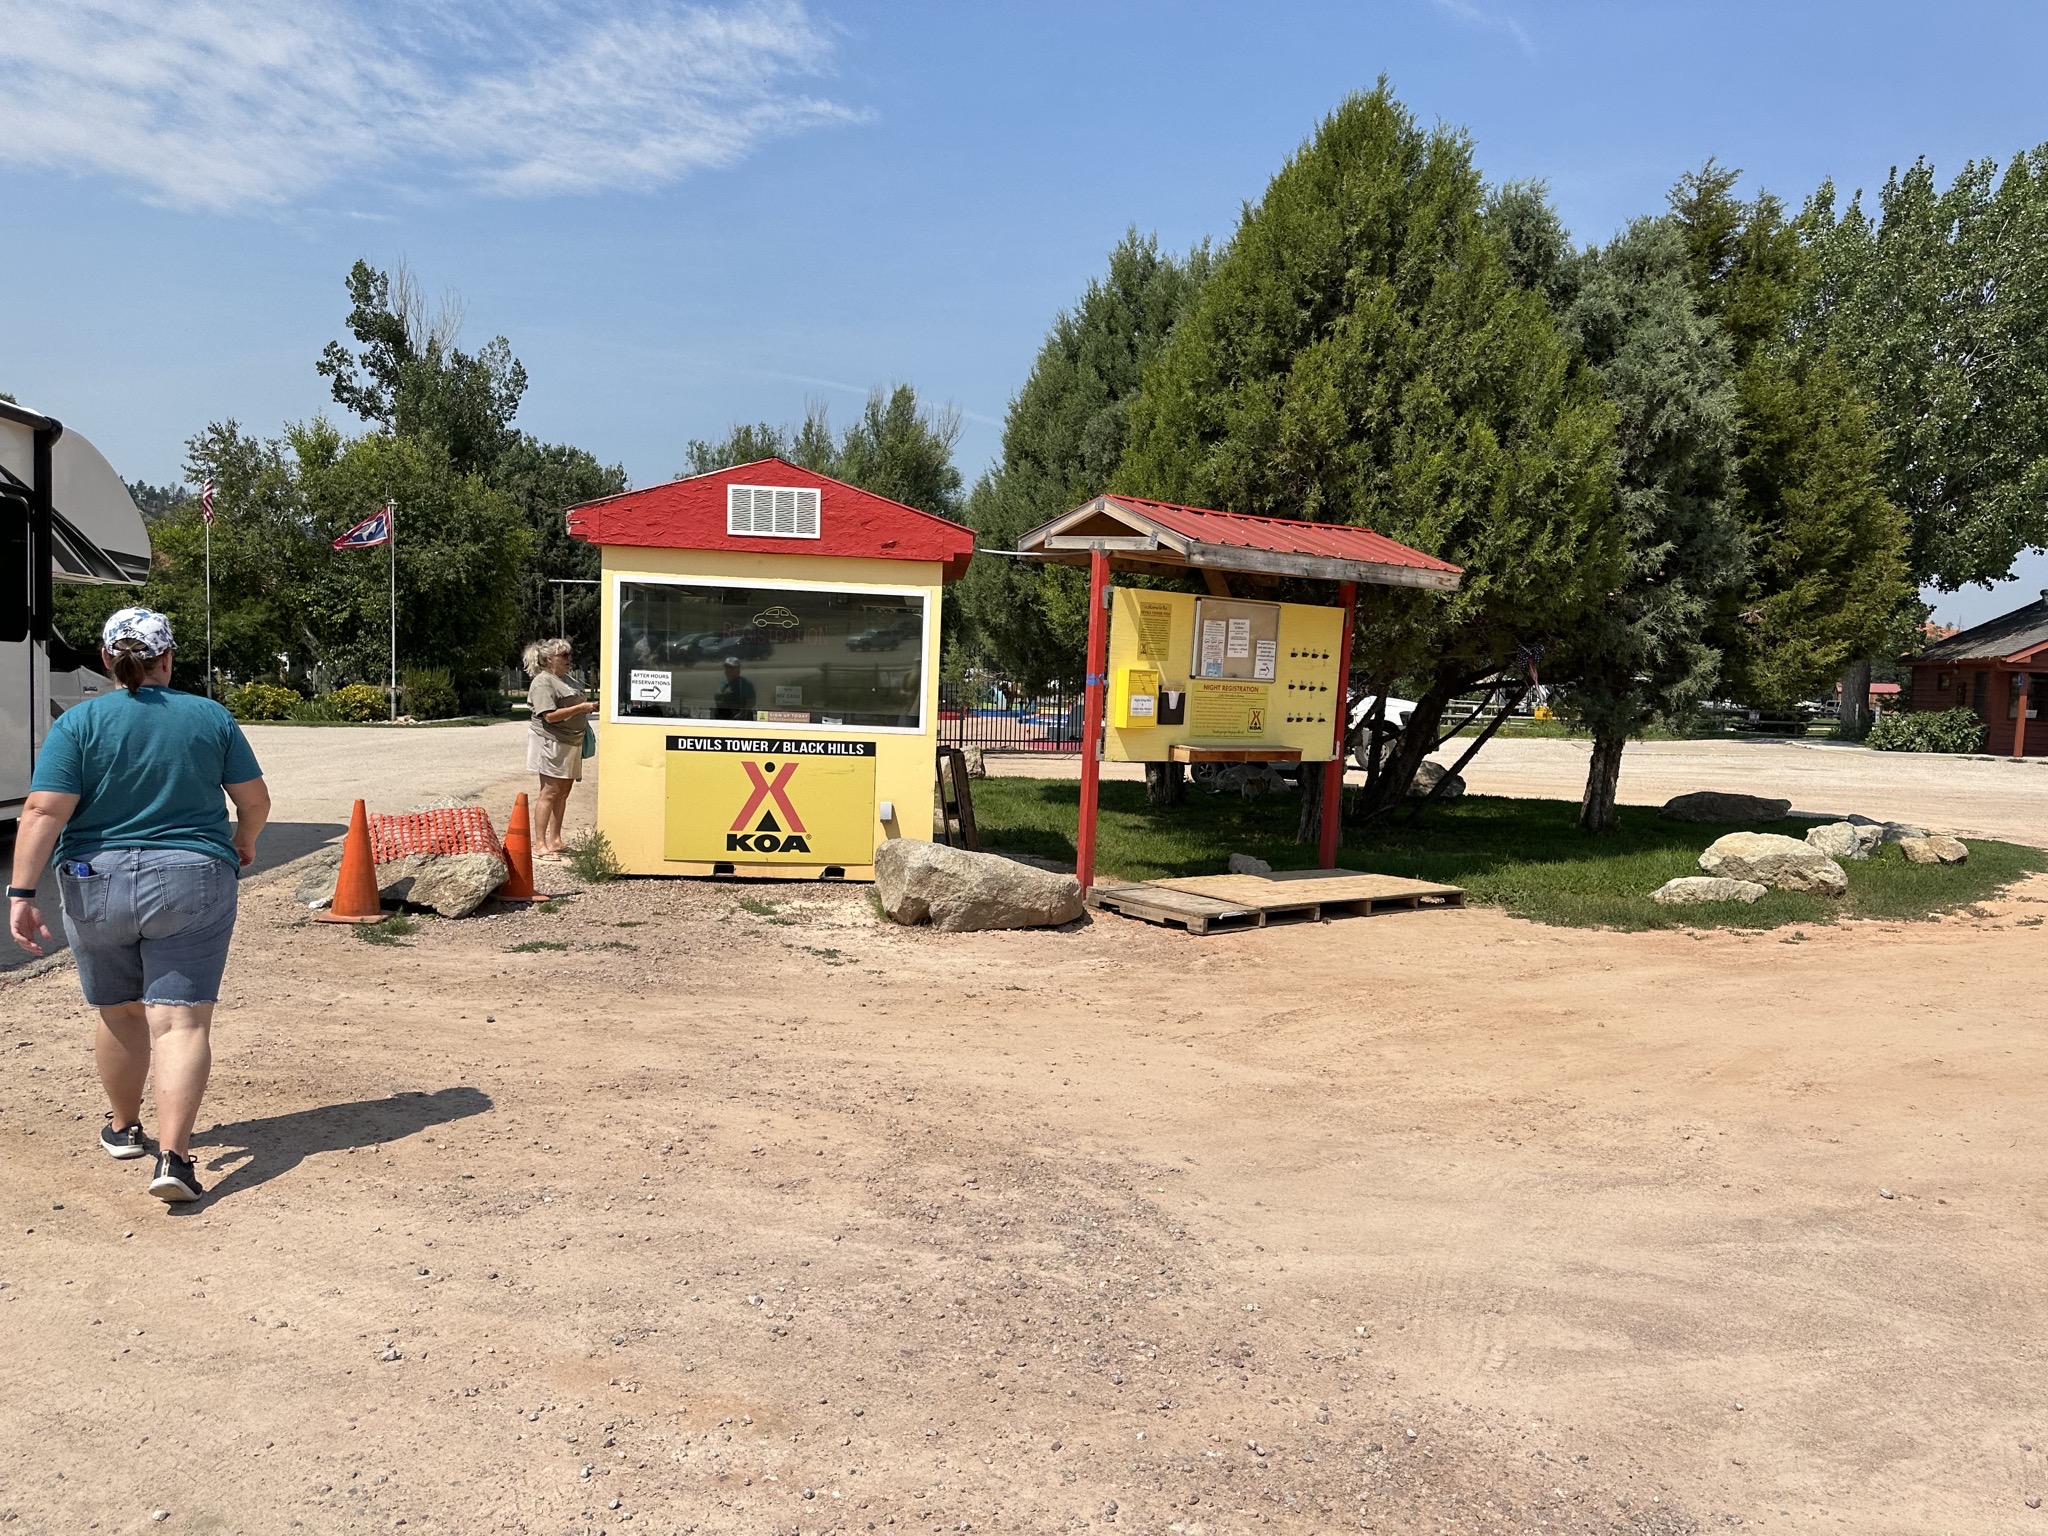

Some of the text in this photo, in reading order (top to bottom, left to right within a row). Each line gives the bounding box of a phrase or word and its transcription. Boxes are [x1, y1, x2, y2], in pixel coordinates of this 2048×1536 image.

[723, 621, 829, 646] REGISTRATION
[678, 738, 722, 751] DEVILS
[725, 740, 769, 752] TOWER
[782, 742, 825, 754] BLACK
[828, 743, 864, 755] HILLS
